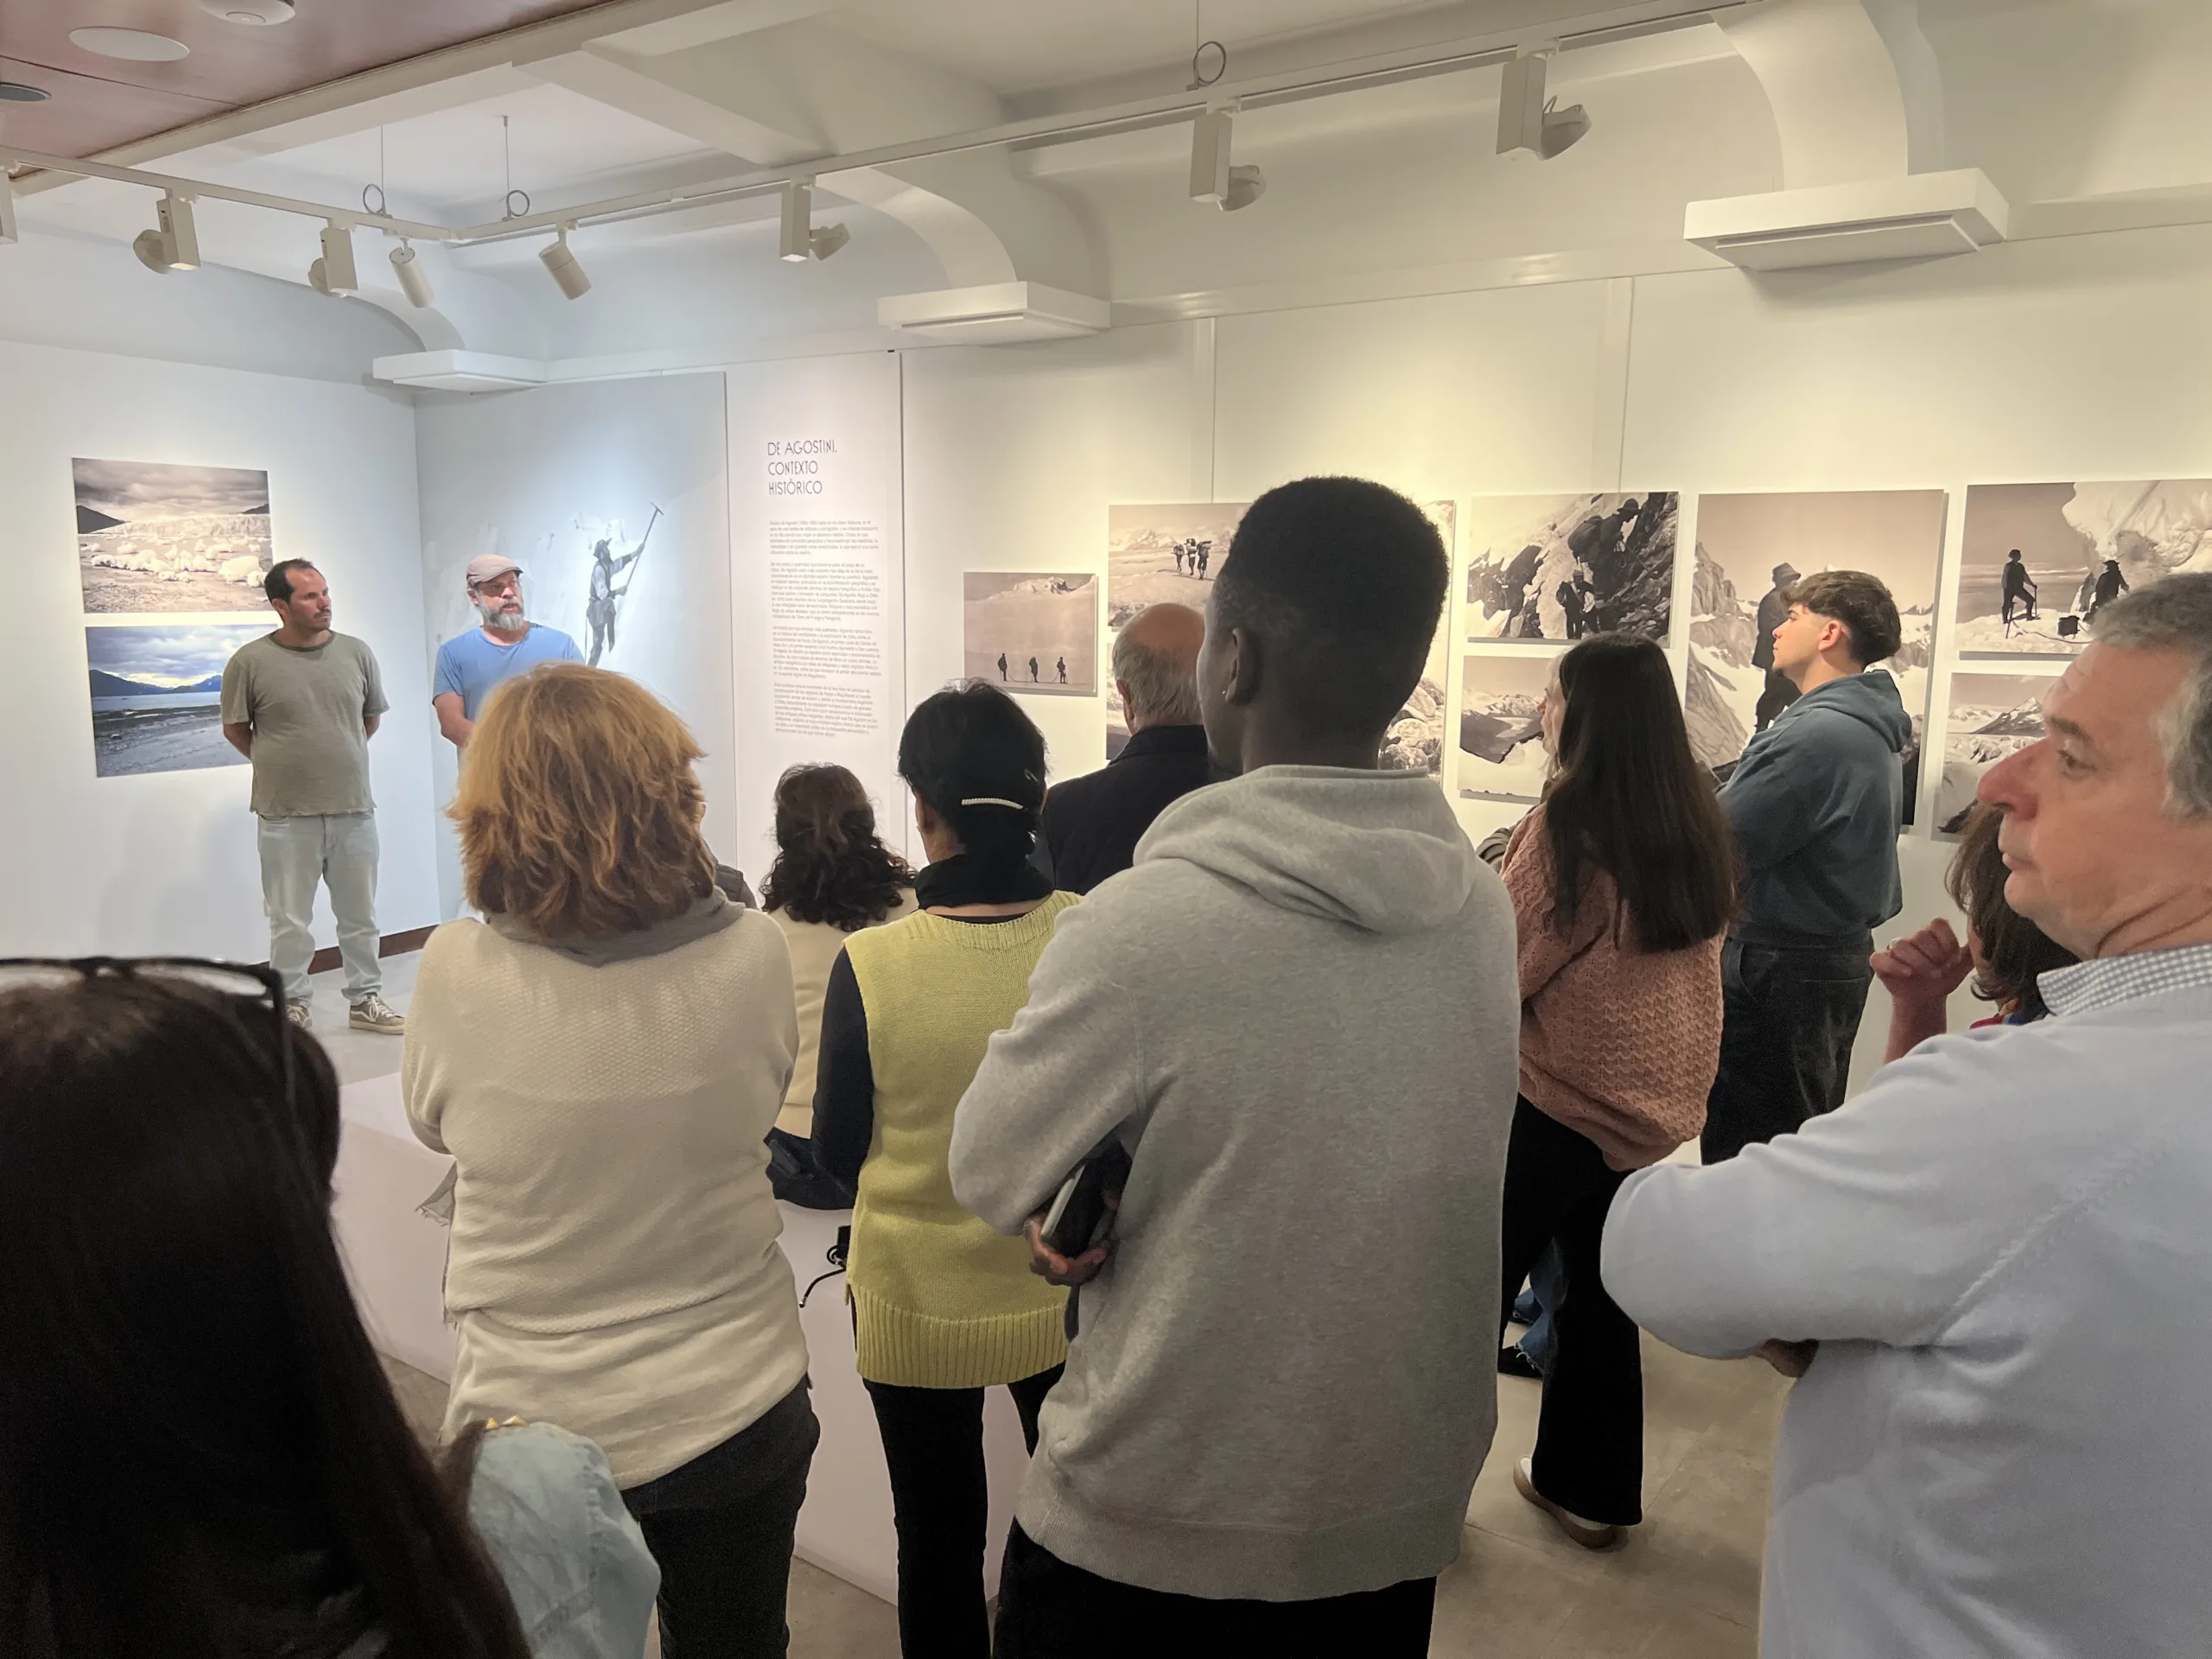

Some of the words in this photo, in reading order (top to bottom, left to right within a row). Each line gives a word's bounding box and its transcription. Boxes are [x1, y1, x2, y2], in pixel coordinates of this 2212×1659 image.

[767, 442, 780, 455] DE
[767, 460, 818, 475] CONTEXTO
[768, 478, 823, 495] HISTÓRICO
